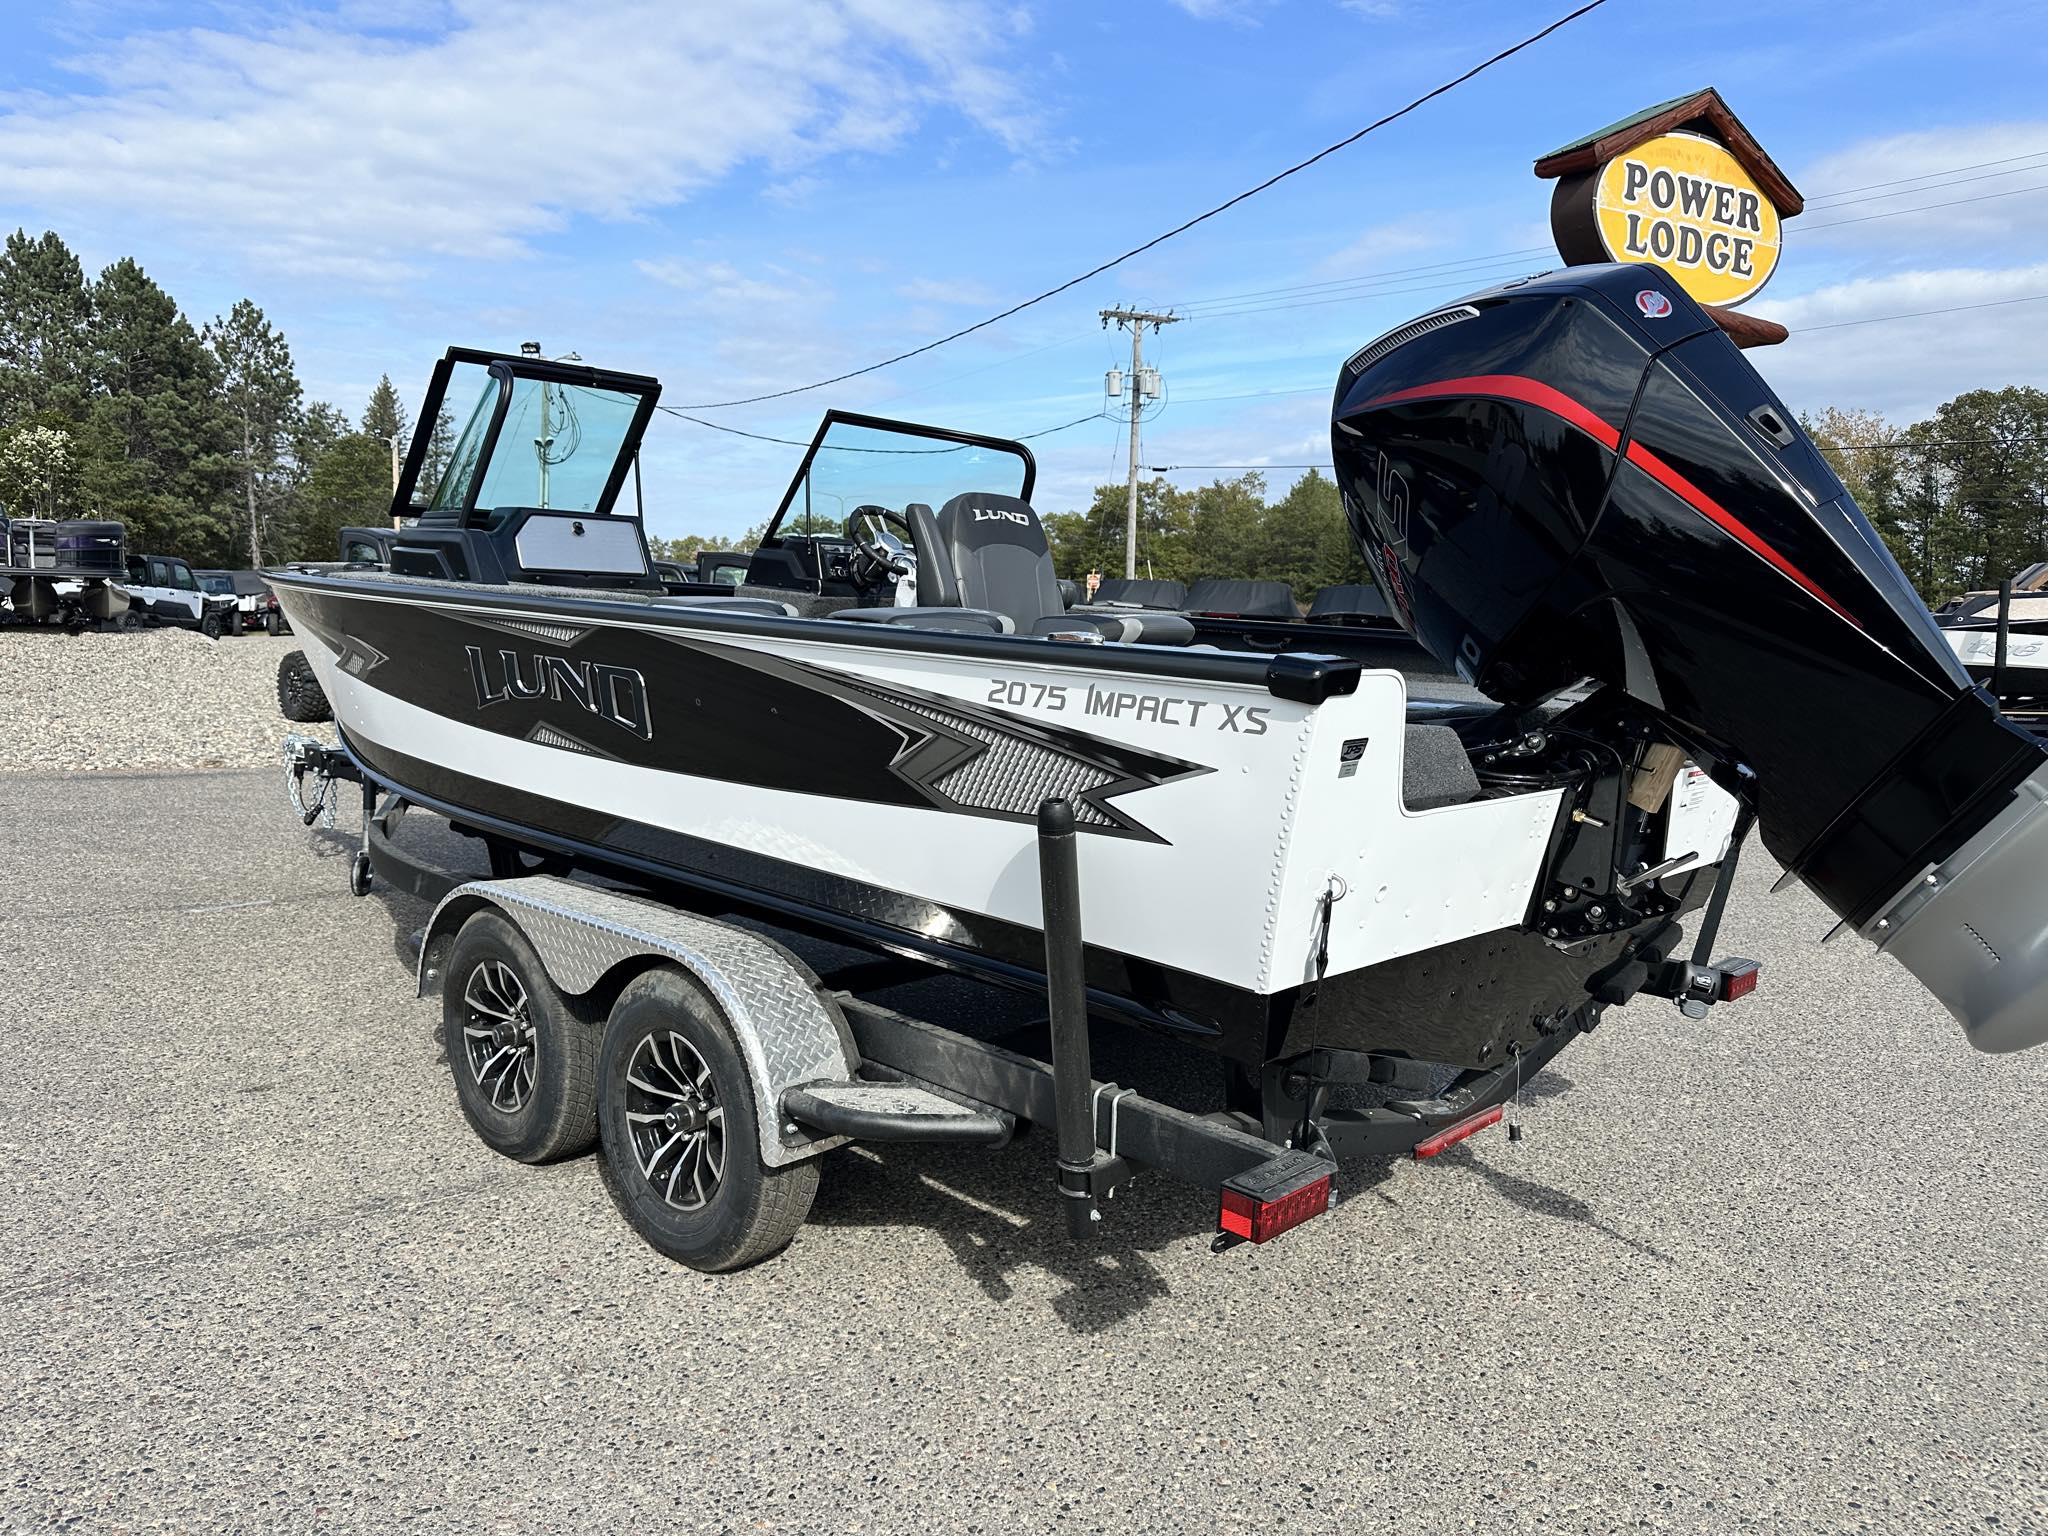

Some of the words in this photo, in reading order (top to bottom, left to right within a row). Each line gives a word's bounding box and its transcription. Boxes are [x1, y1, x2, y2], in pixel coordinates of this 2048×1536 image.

[1624, 162, 1760, 232] POWER
[1626, 213, 1753, 276] LODGE
[973, 508, 1030, 526] LUND
[465, 645, 653, 741] LUND
[987, 679, 1068, 711] 2075
[1084, 682, 1208, 728] IMPACT
[1217, 703, 1272, 736] XS
